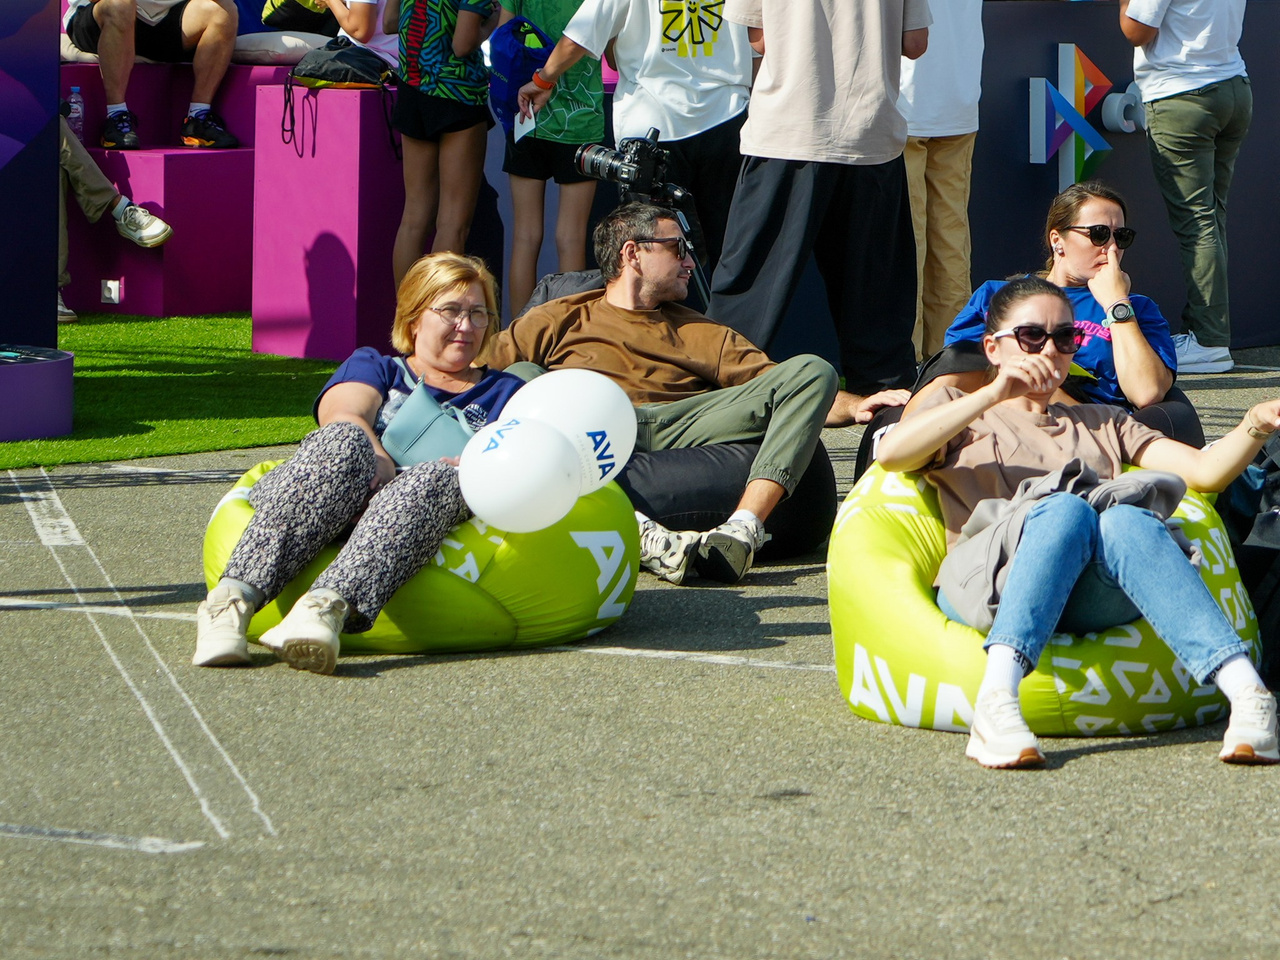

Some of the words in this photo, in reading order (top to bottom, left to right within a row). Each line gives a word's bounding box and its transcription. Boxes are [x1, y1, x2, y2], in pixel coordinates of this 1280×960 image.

[481, 418, 520, 453] AVA
[585, 430, 616, 481] AVA
[569, 530, 631, 637] AV
[849, 642, 975, 734] AVA
